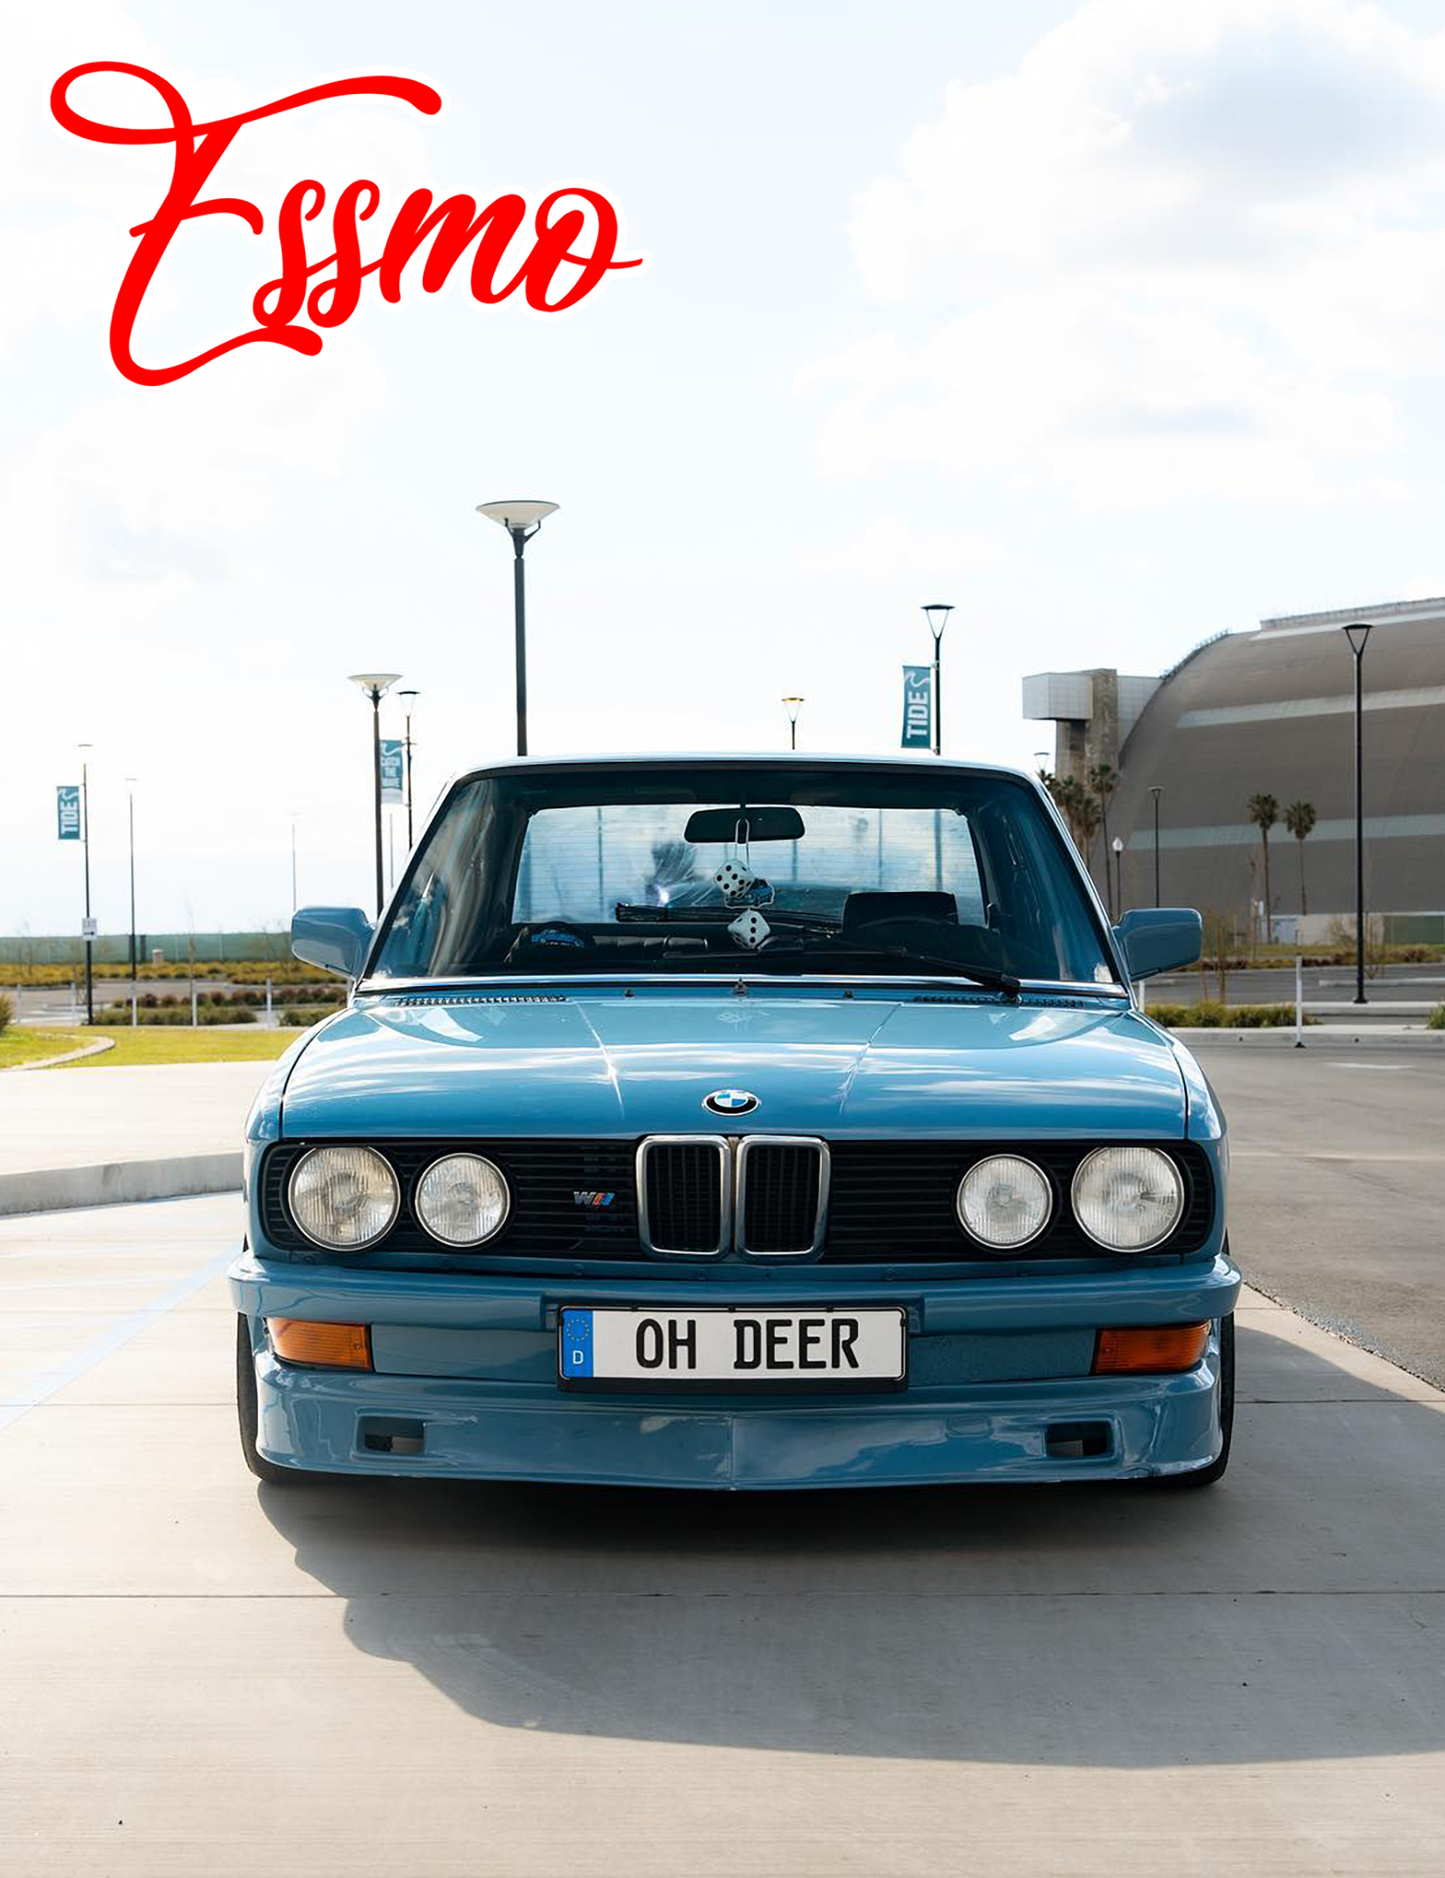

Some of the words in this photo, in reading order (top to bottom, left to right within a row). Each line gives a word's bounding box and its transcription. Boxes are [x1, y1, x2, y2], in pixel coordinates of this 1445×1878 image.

[906, 691, 928, 739] TIDE
[60, 801, 78, 835] TIDE
[573, 1351, 584, 1365] D
[635, 1318, 697, 1370] OH
[733, 1318, 860, 1370] DEER
